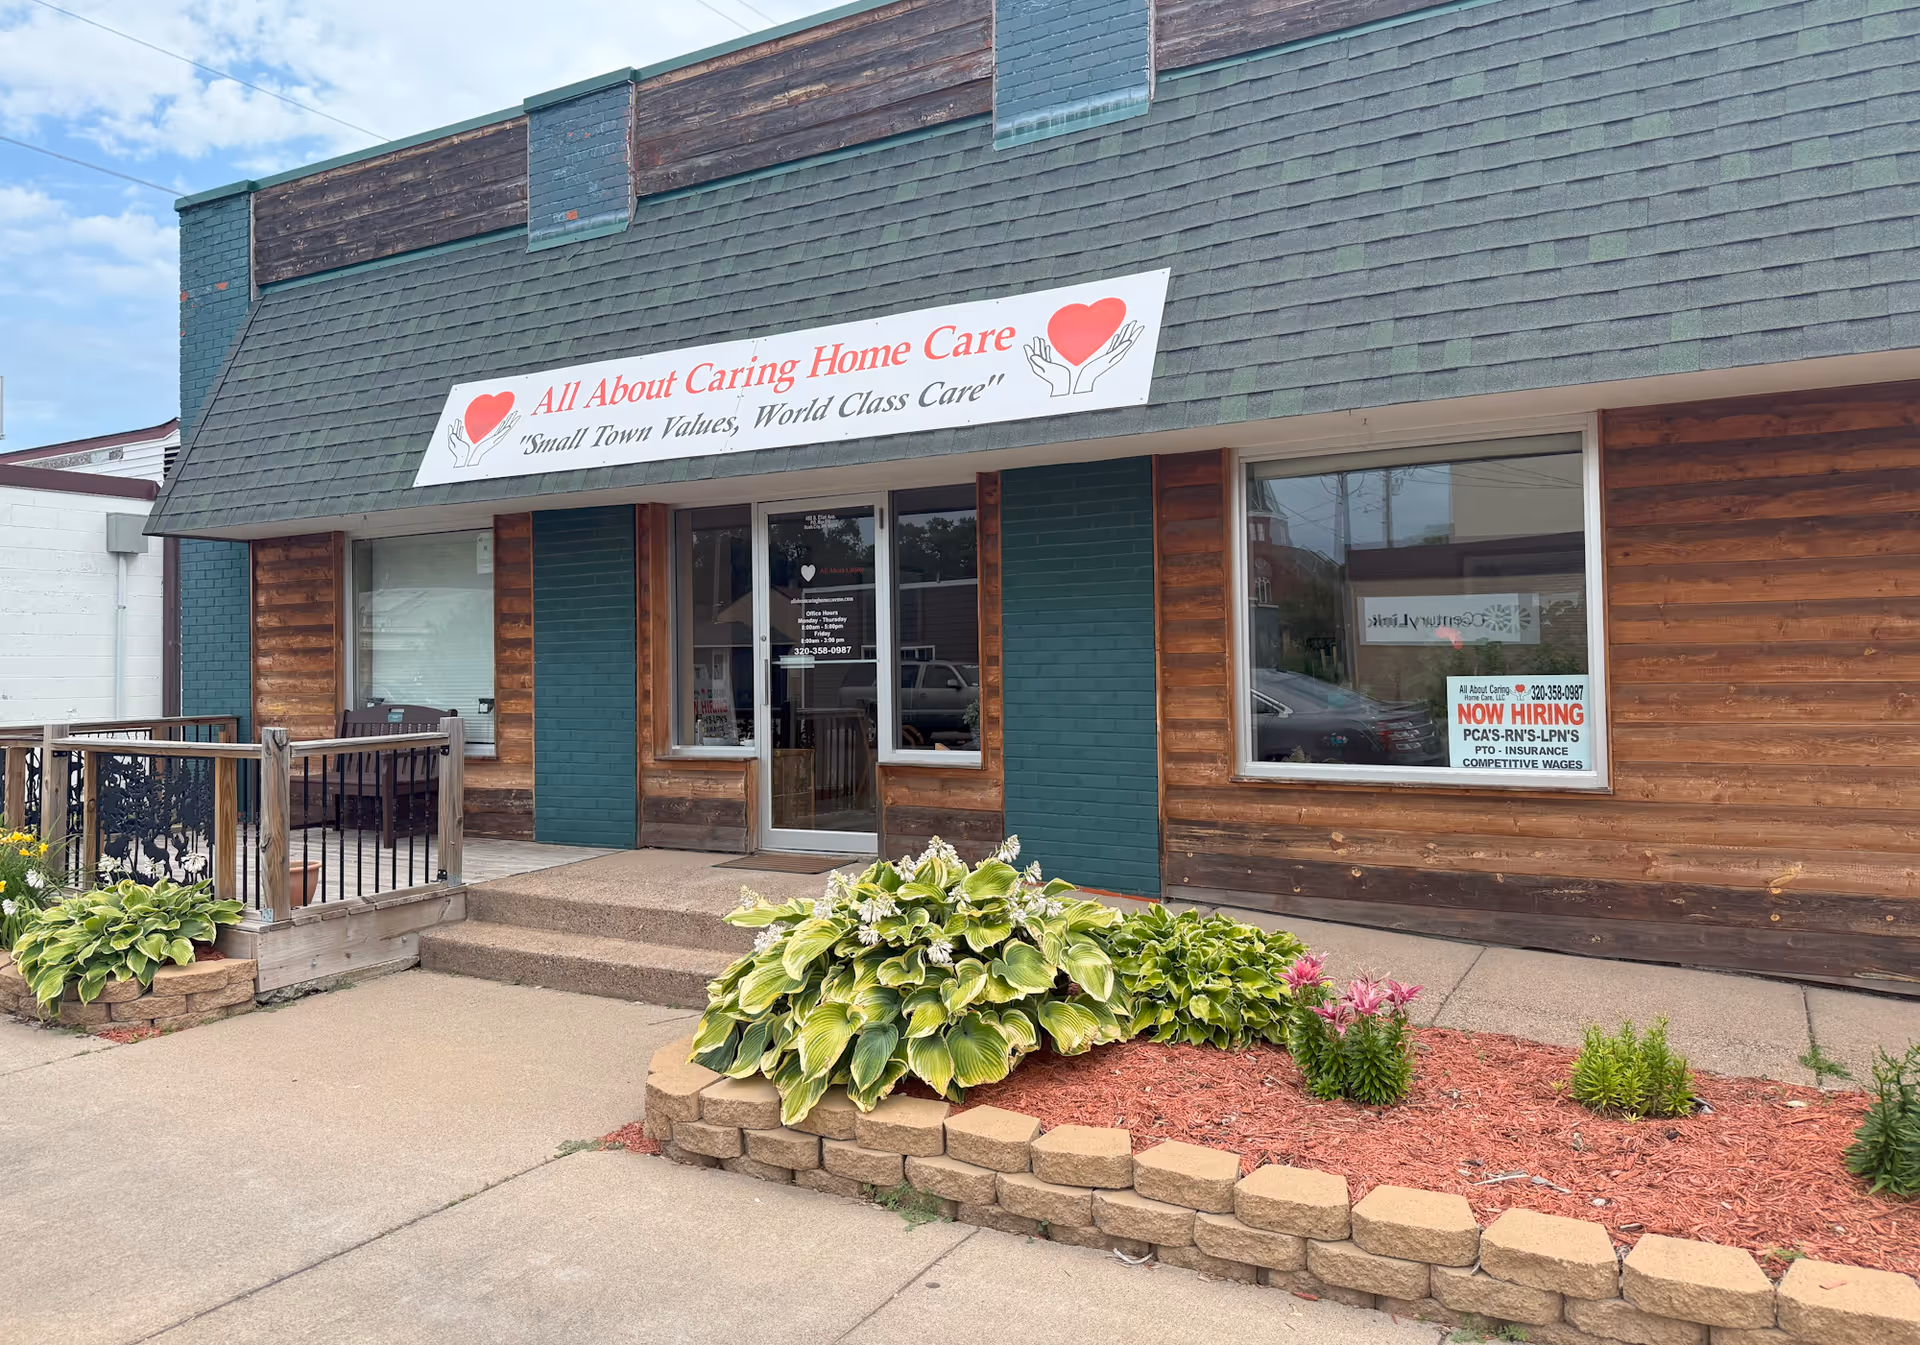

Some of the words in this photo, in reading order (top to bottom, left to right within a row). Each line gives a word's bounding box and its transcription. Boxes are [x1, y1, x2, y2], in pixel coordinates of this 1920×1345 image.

[530, 380, 581, 416] All
[584, 375, 678, 407] About
[684, 356, 801, 394] Caring
[808, 342, 911, 378] Home
[923, 325, 1018, 360] Care
[518, 426, 589, 455] "Small
[590, 423, 653, 448] Town
[661, 412, 740, 439] Values,
[753, 394, 836, 430] World
[838, 390, 910, 418] Class
[918, 373, 1006, 408] Care"
[794, 646, 852, 655] 320-358-0987
[1459, 684, 1468, 694] All
[1470, 684, 1488, 694] About
[1489, 684, 1510, 696] Caring
[1531, 684, 1584, 701] 320-358-0987
[1457, 703, 1504, 725] NOW
[1511, 703, 1584, 726] HIRING
[1463, 728, 1580, 743] PCA'S-RN'S-LPN'S
[1475, 746, 1496, 754] PTO
[1505, 746, 1569, 756] INSURANCE
[1462, 758, 1538, 769] COMPETITIVE
[1542, 759, 1583, 769] WAGES
